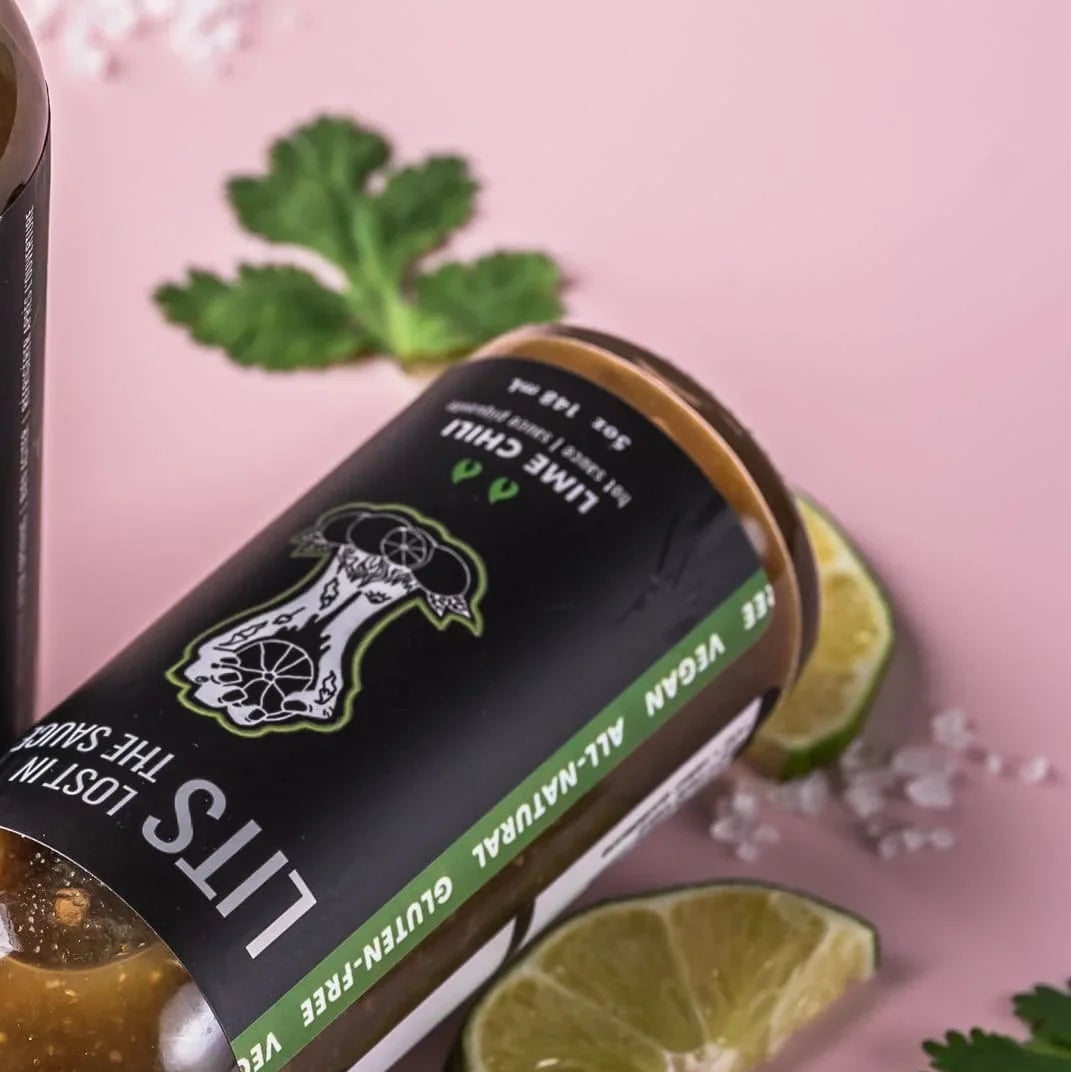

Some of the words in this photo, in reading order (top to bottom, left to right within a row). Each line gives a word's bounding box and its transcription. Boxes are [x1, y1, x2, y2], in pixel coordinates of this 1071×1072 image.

[538, 390, 581, 418] 148
[440, 417, 523, 460] CHILI
[506, 414, 554, 444] sauce
[522, 452, 600, 514] LIME
[560, 443, 608, 482] sauce
[602, 477, 633, 509] hot
[644, 632, 726, 717] VEGAN
[9, 721, 113, 753] SAUCE
[99, 732, 176, 784] THE
[7, 756, 59, 784] IN
[42, 763, 139, 817] LOST
[471, 716, 625, 869] ALL-NATURAL
[141, 778, 318, 960] LITS
[299, 875, 454, 1028] GLUTEN-FREE
